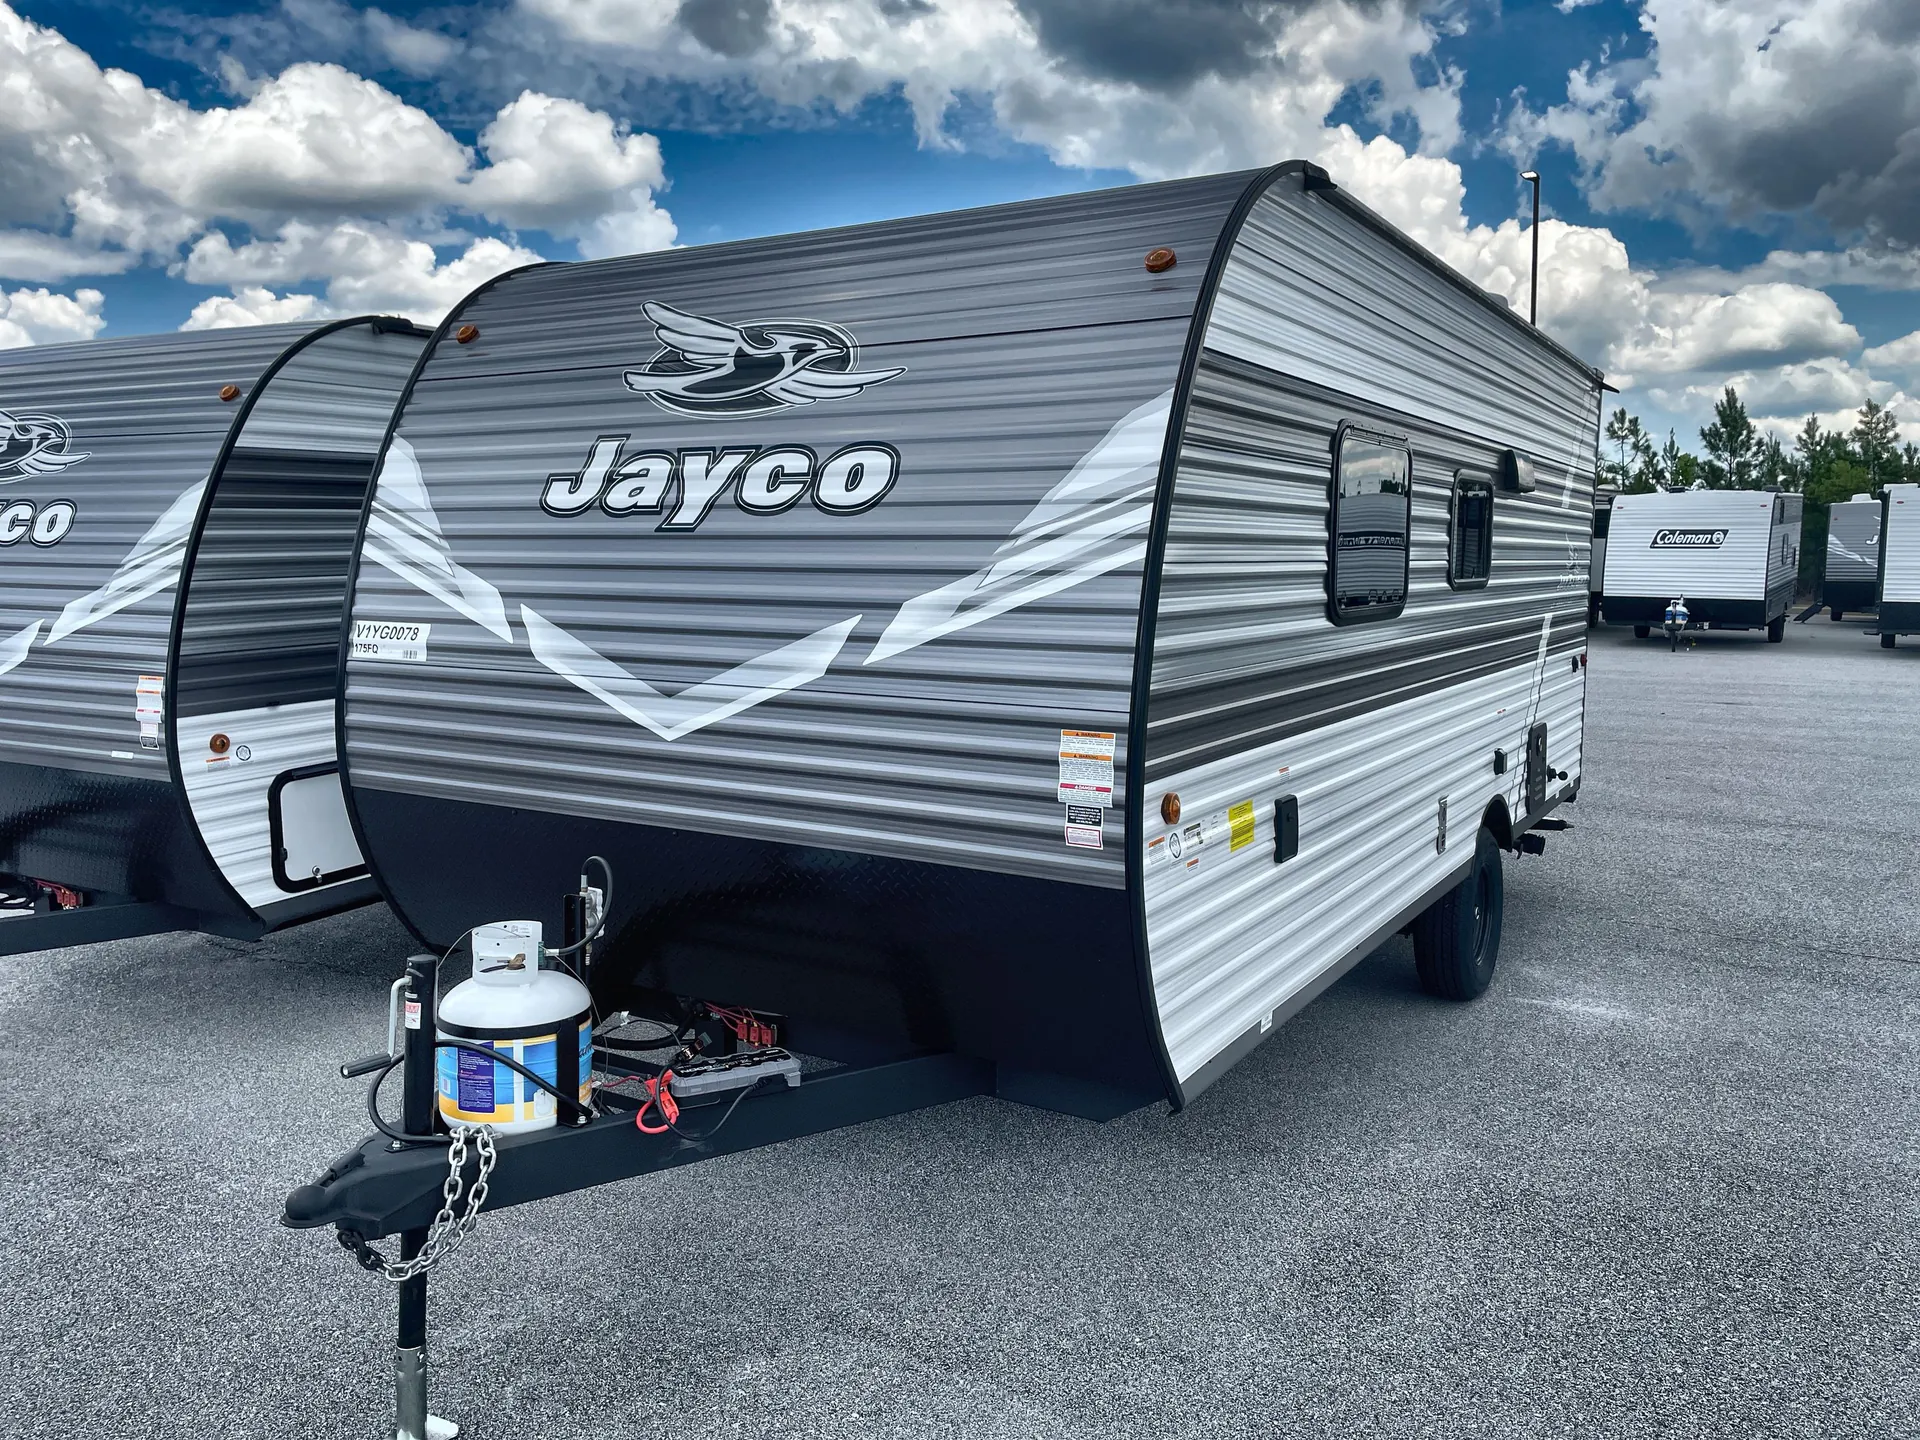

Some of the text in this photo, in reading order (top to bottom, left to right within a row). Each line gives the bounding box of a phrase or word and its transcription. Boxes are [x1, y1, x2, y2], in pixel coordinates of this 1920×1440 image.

[540, 434, 901, 532] Jayco
[0, 499, 77, 548] co
[1656, 530, 1712, 545] Coleman
[357, 624, 420, 641] V1YG0078
[355, 643, 379, 654] 175FQ
